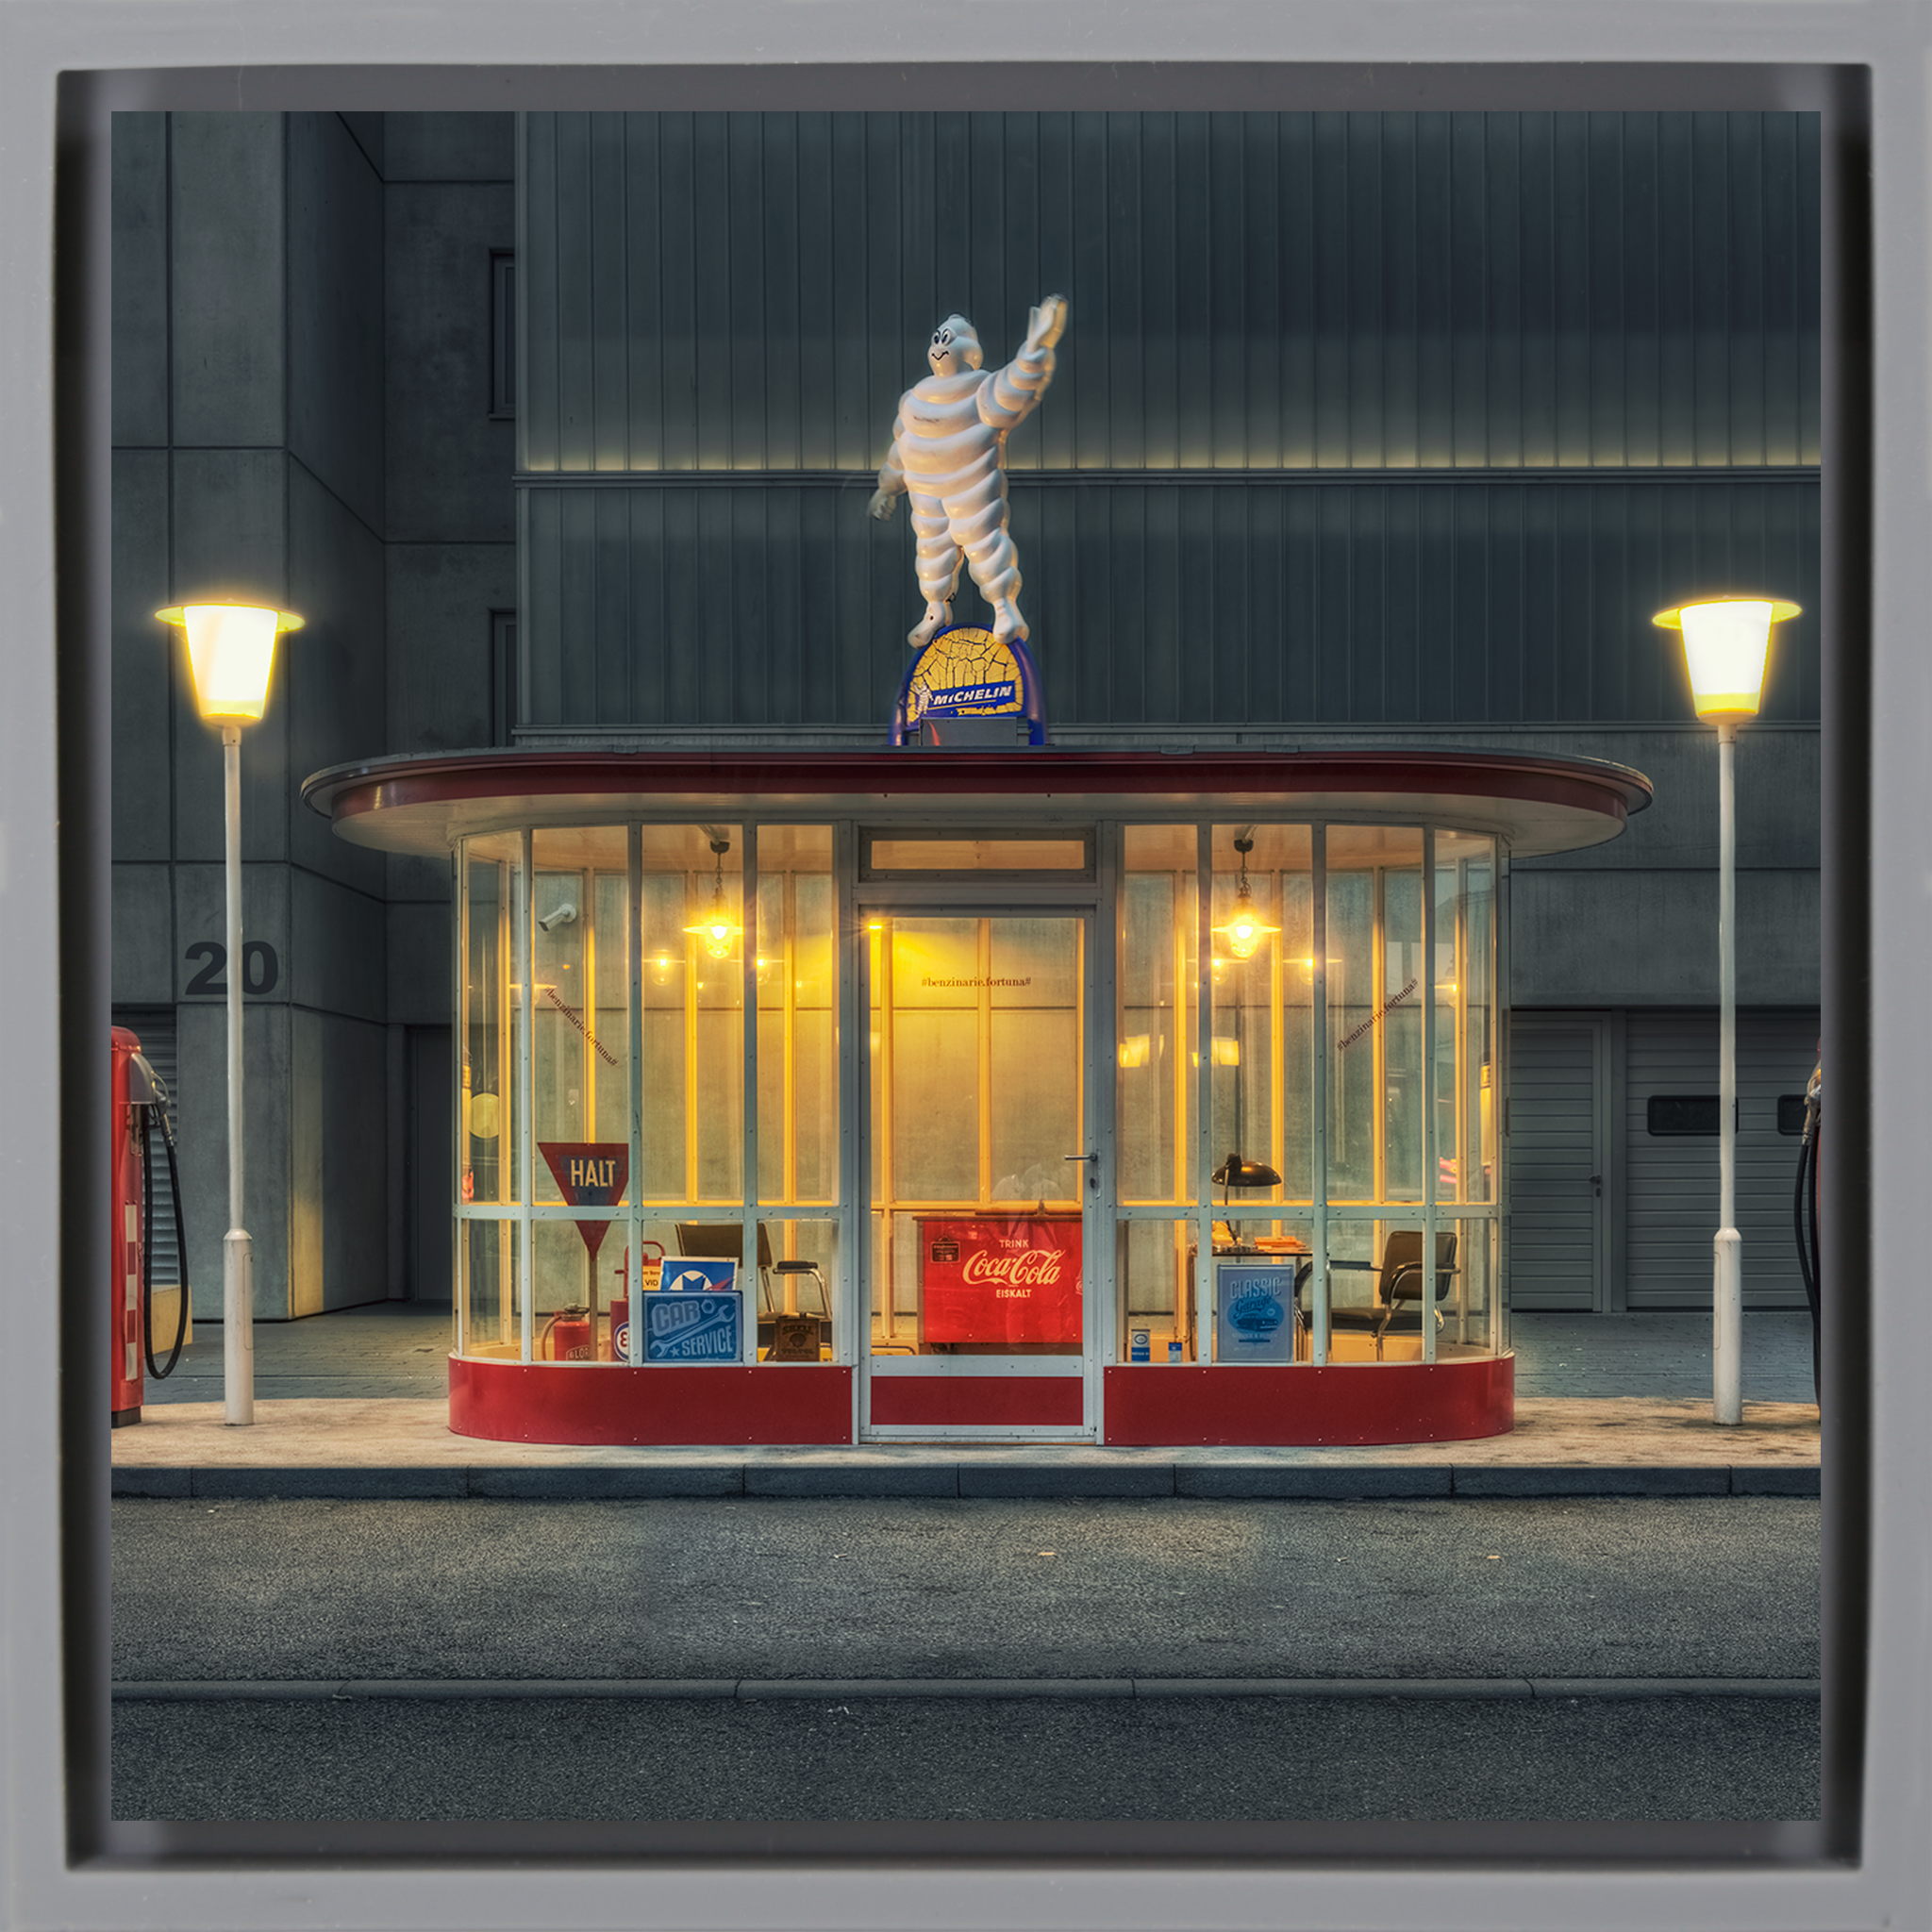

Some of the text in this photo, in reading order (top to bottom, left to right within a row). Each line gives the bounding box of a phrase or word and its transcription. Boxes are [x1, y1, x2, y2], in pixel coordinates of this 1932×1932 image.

[933, 686, 1012, 706] MICHELIN
[185, 941, 278, 996] 20
[921, 976, 1032, 988] #benzinarie.fortuna#
[570, 1159, 616, 1188] HALT
[1000, 1239, 1029, 1248] TRINK
[996, 1289, 1032, 1298] EISKALT
[1230, 1276, 1281, 1299] CLASSIC
[652, 1301, 701, 1336] CAR
[681, 1325, 733, 1357] SERVICE
